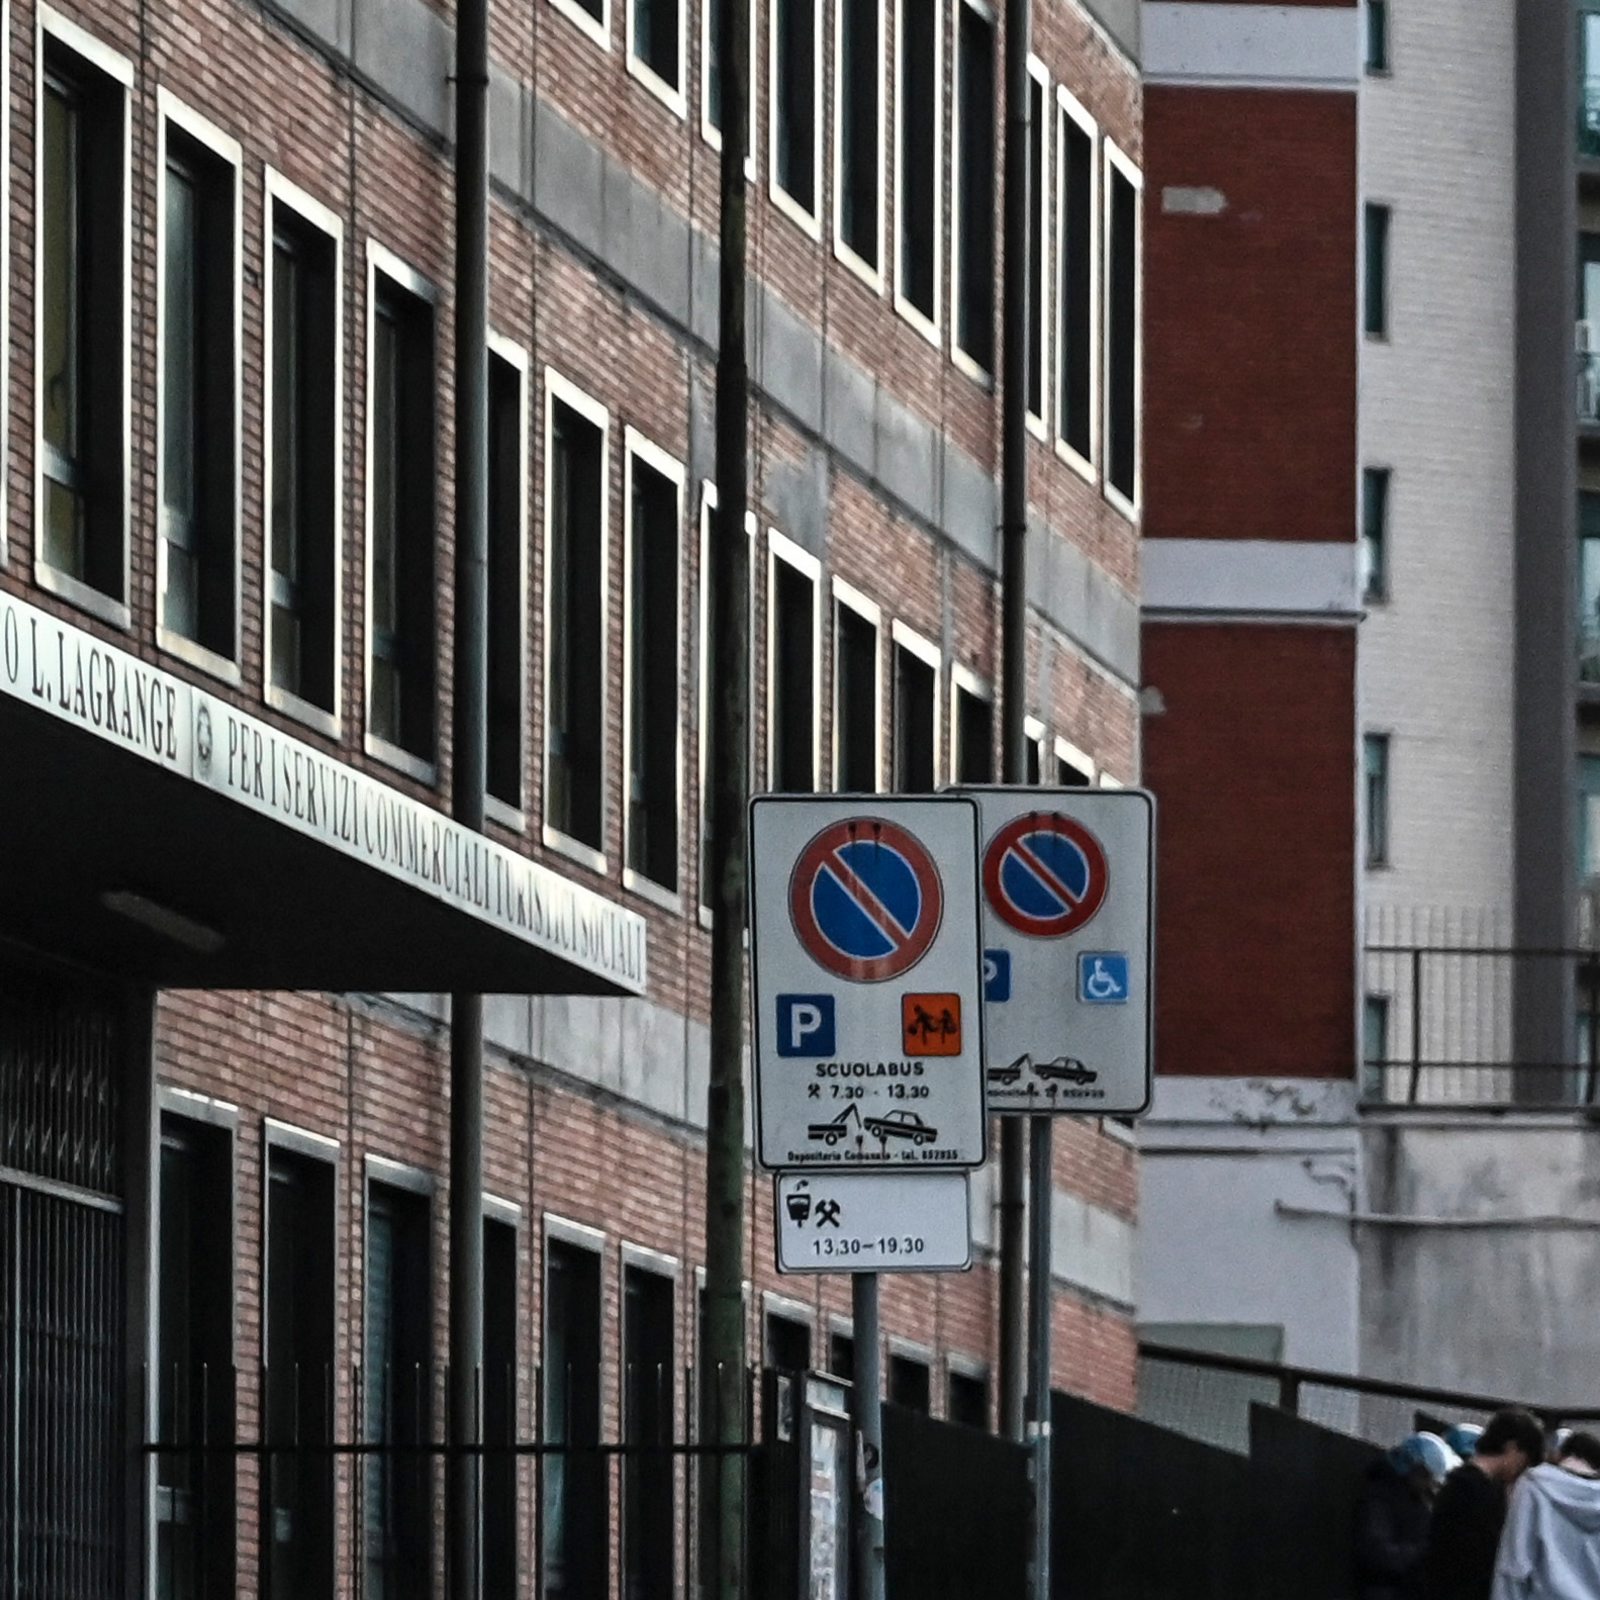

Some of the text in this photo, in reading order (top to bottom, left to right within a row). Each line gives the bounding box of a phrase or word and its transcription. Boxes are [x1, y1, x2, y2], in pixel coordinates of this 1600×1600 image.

[228, 717, 264, 801] PER
[282, 744, 359, 847] SERVIZI
[364, 787, 490, 911] COMMERCIALI
[495, 854, 577, 952] TURISTICI
[582, 902, 642, 984] SOCIALI
[791, 1003, 822, 1047] P
[815, 1061, 925, 1078] SCUOLABUS
